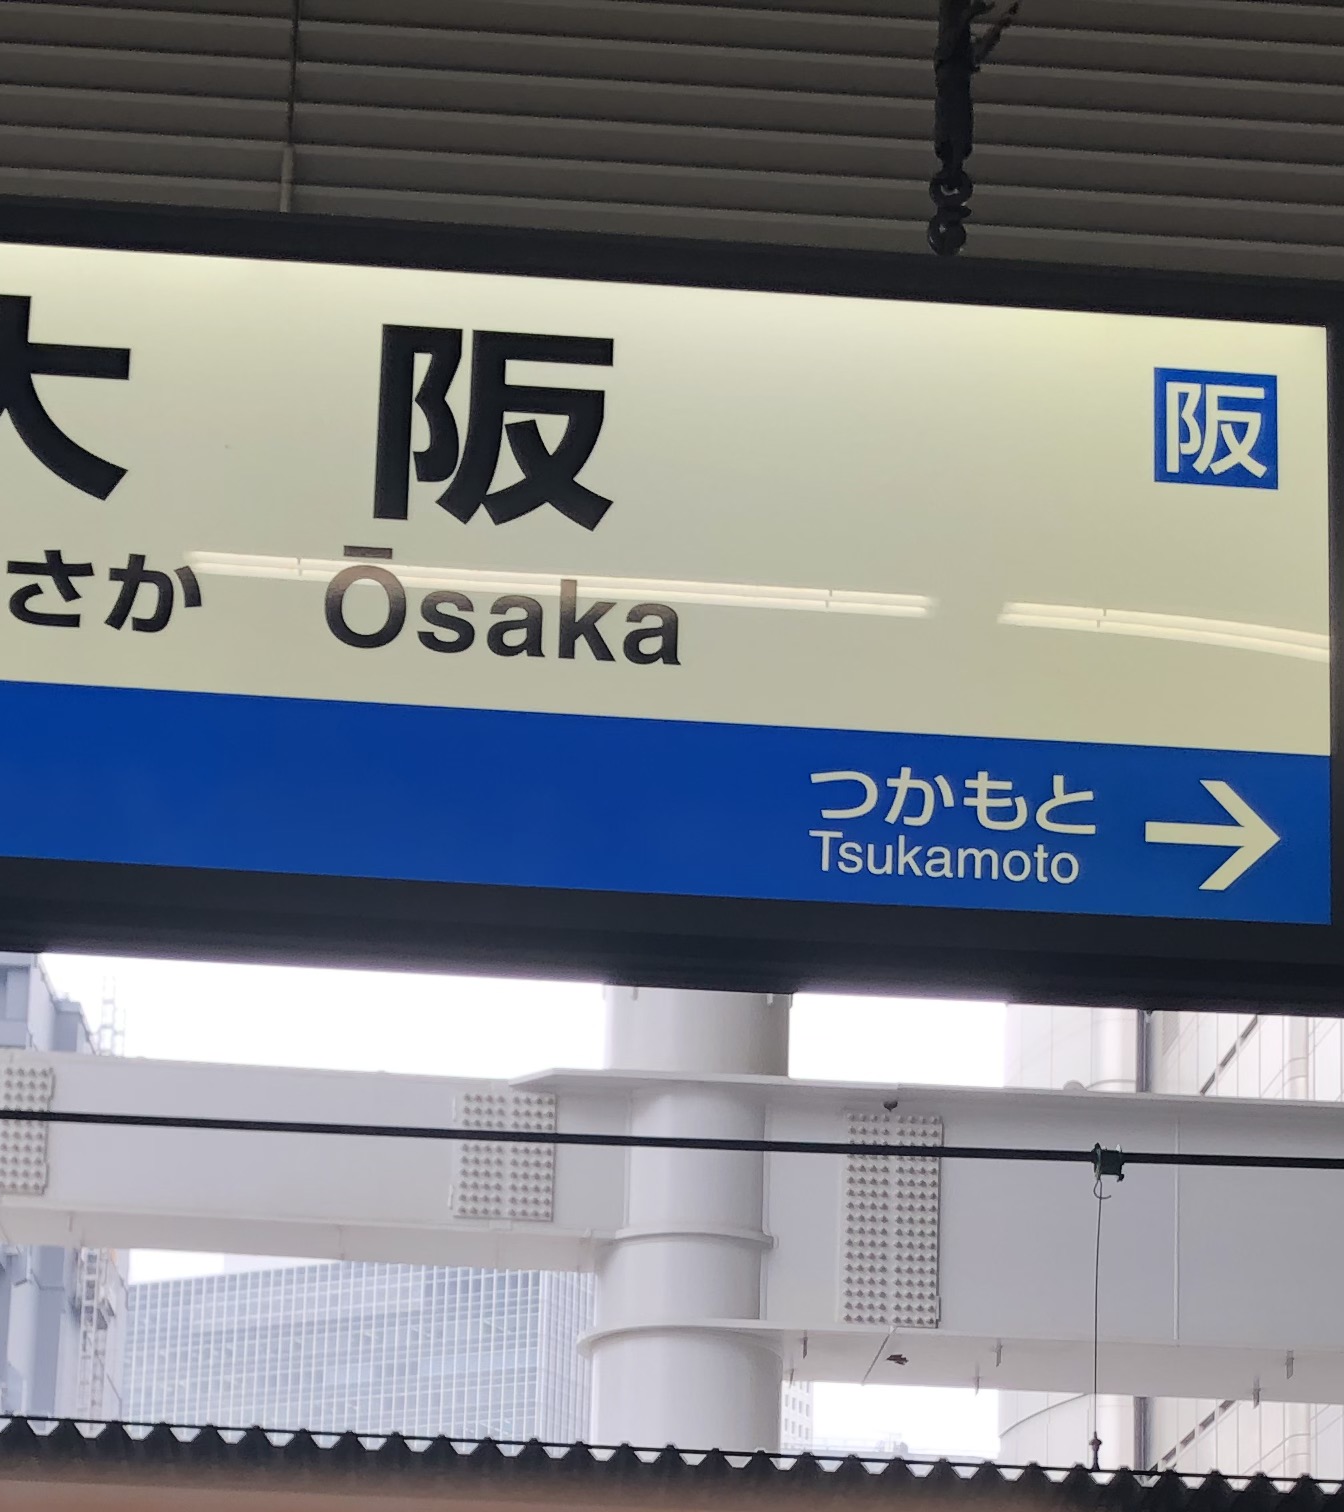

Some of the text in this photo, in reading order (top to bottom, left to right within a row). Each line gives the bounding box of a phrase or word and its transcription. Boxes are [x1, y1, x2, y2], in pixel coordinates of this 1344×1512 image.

[1164, 379, 1269, 479] 阪
[323, 545, 683, 667] Ōsaka
[808, 765, 1097, 836] つかもと
[809, 829, 1081, 885] Tsukamoto
